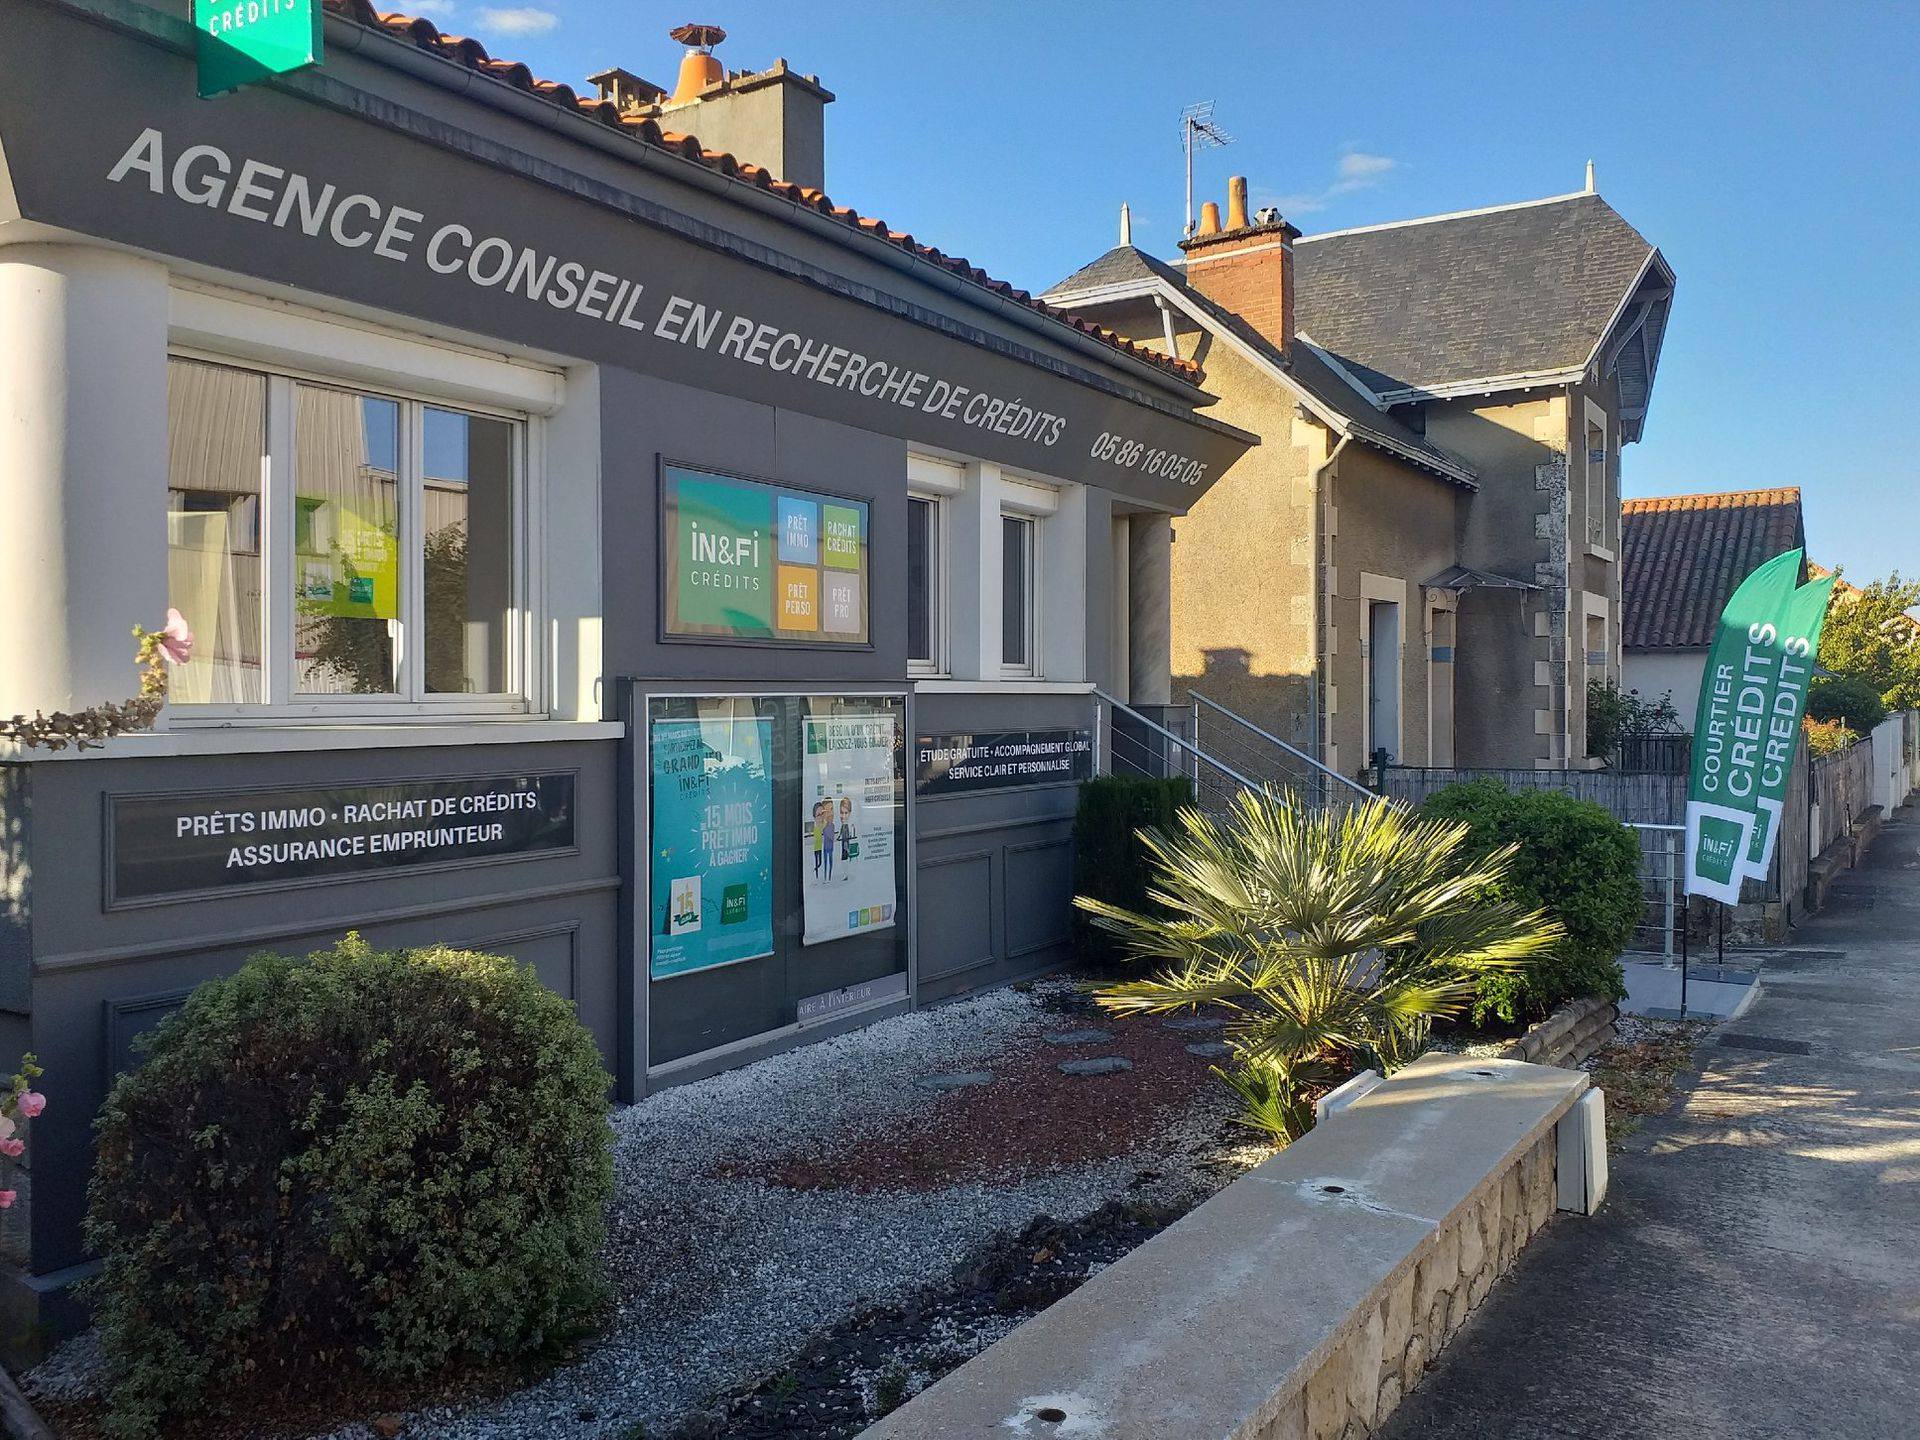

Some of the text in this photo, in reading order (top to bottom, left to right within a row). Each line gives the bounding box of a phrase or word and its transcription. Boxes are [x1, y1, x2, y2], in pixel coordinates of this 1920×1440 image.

[106, 127, 1067, 447] AGENCE CONSEIL EN RECHERCHE DE CRÉDITS
[1090, 432, 1122, 461] 05
[1114, 439, 1145, 468] 86
[1181, 460, 1208, 486] 05
[787, 514, 808, 532] PRÊT
[827, 520, 857, 539] RACHAT
[786, 531, 809, 548] IMMO
[827, 535, 857, 554] CRÉDITS
[691, 570, 760, 592] CRÉDITS
[787, 582, 808, 600] PRÊT
[832, 586, 852, 603] PRÊT
[785, 600, 811, 616] PERSO
[834, 603, 850, 618] PRO
[1728, 622, 1776, 797] CRÉDITS
[1702, 664, 1734, 792] COURTIER
[920, 741, 1091, 762] ÉTUDE GRATUITE ACCOMPAGNEMENT GLOBAL
[663, 754, 700, 774] GRAND
[949, 766, 983, 780] SERVICE
[984, 764, 1007, 777] CLAIR
[1007, 763, 1017, 775] ET
[176, 791, 537, 838] PRÊTS IMMO RACHAT DE CRÉDITS
[704, 801, 753, 828] 15 MOIS
[226, 823, 503, 869] ASSURANCE EMPRUNTEUR
[732, 825, 758, 847] IMMO
